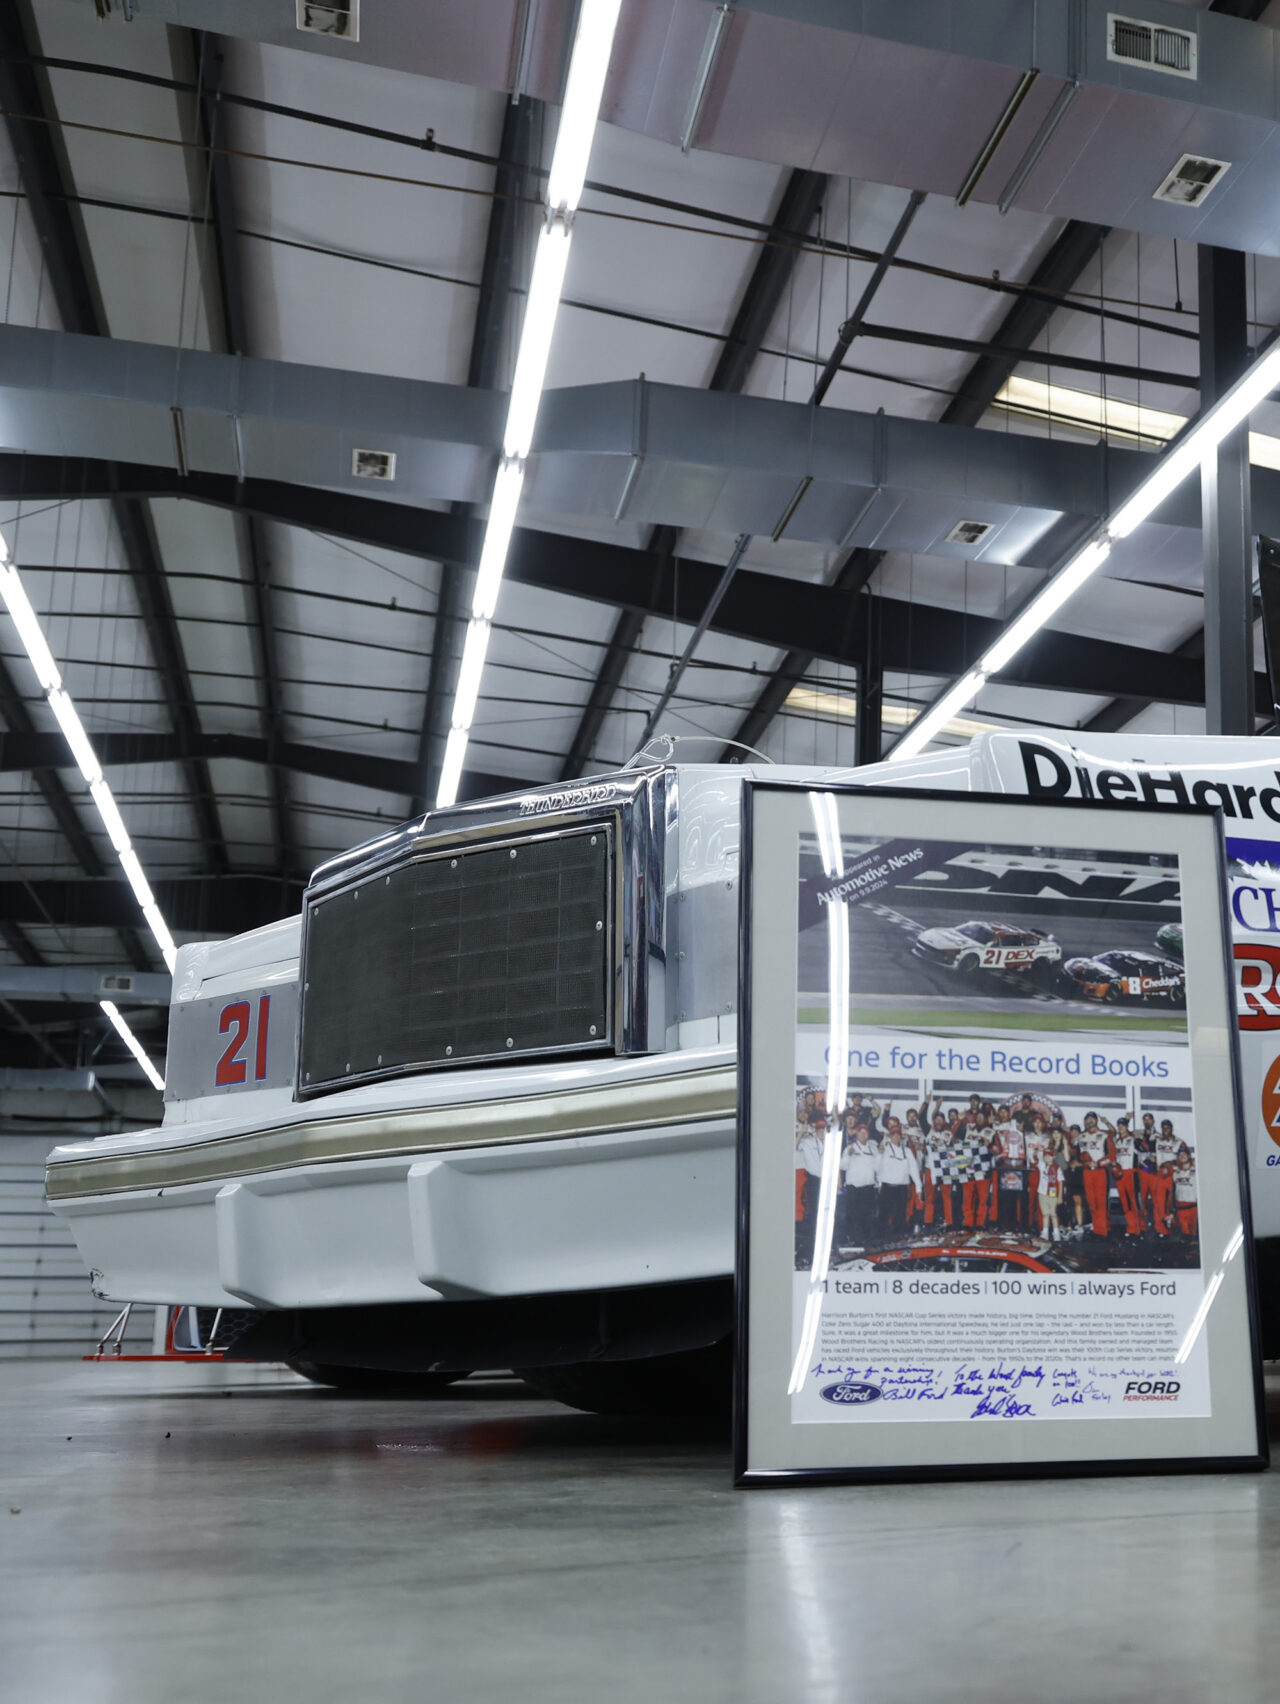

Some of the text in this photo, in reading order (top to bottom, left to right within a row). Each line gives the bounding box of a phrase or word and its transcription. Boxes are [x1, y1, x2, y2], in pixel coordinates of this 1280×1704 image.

[816, 863, 890, 907] Automotive
[887, 847, 925, 872] News
[984, 950, 1003, 965] 21
[1004, 949, 1036, 961] DEX
[1128, 977, 1142, 995] 8
[214, 994, 271, 1087] 21
[889, 1046, 928, 1070] for
[936, 1048, 980, 1071] the
[990, 1050, 1081, 1076] Record
[1091, 1053, 1170, 1079] Books
[835, 1282, 880, 1295] team
[892, 1280, 903, 1294] 8
[908, 1279, 981, 1296] decades
[992, 1279, 1022, 1295] 100
[1027, 1280, 1068, 1296] wins
[1078, 1280, 1135, 1299] always
[1140, 1280, 1177, 1296] Ford
[832, 1384, 872, 1402] Ford
[1124, 1381, 1181, 1395] FORD
[1122, 1394, 1180, 1402] PERFORMANCE
